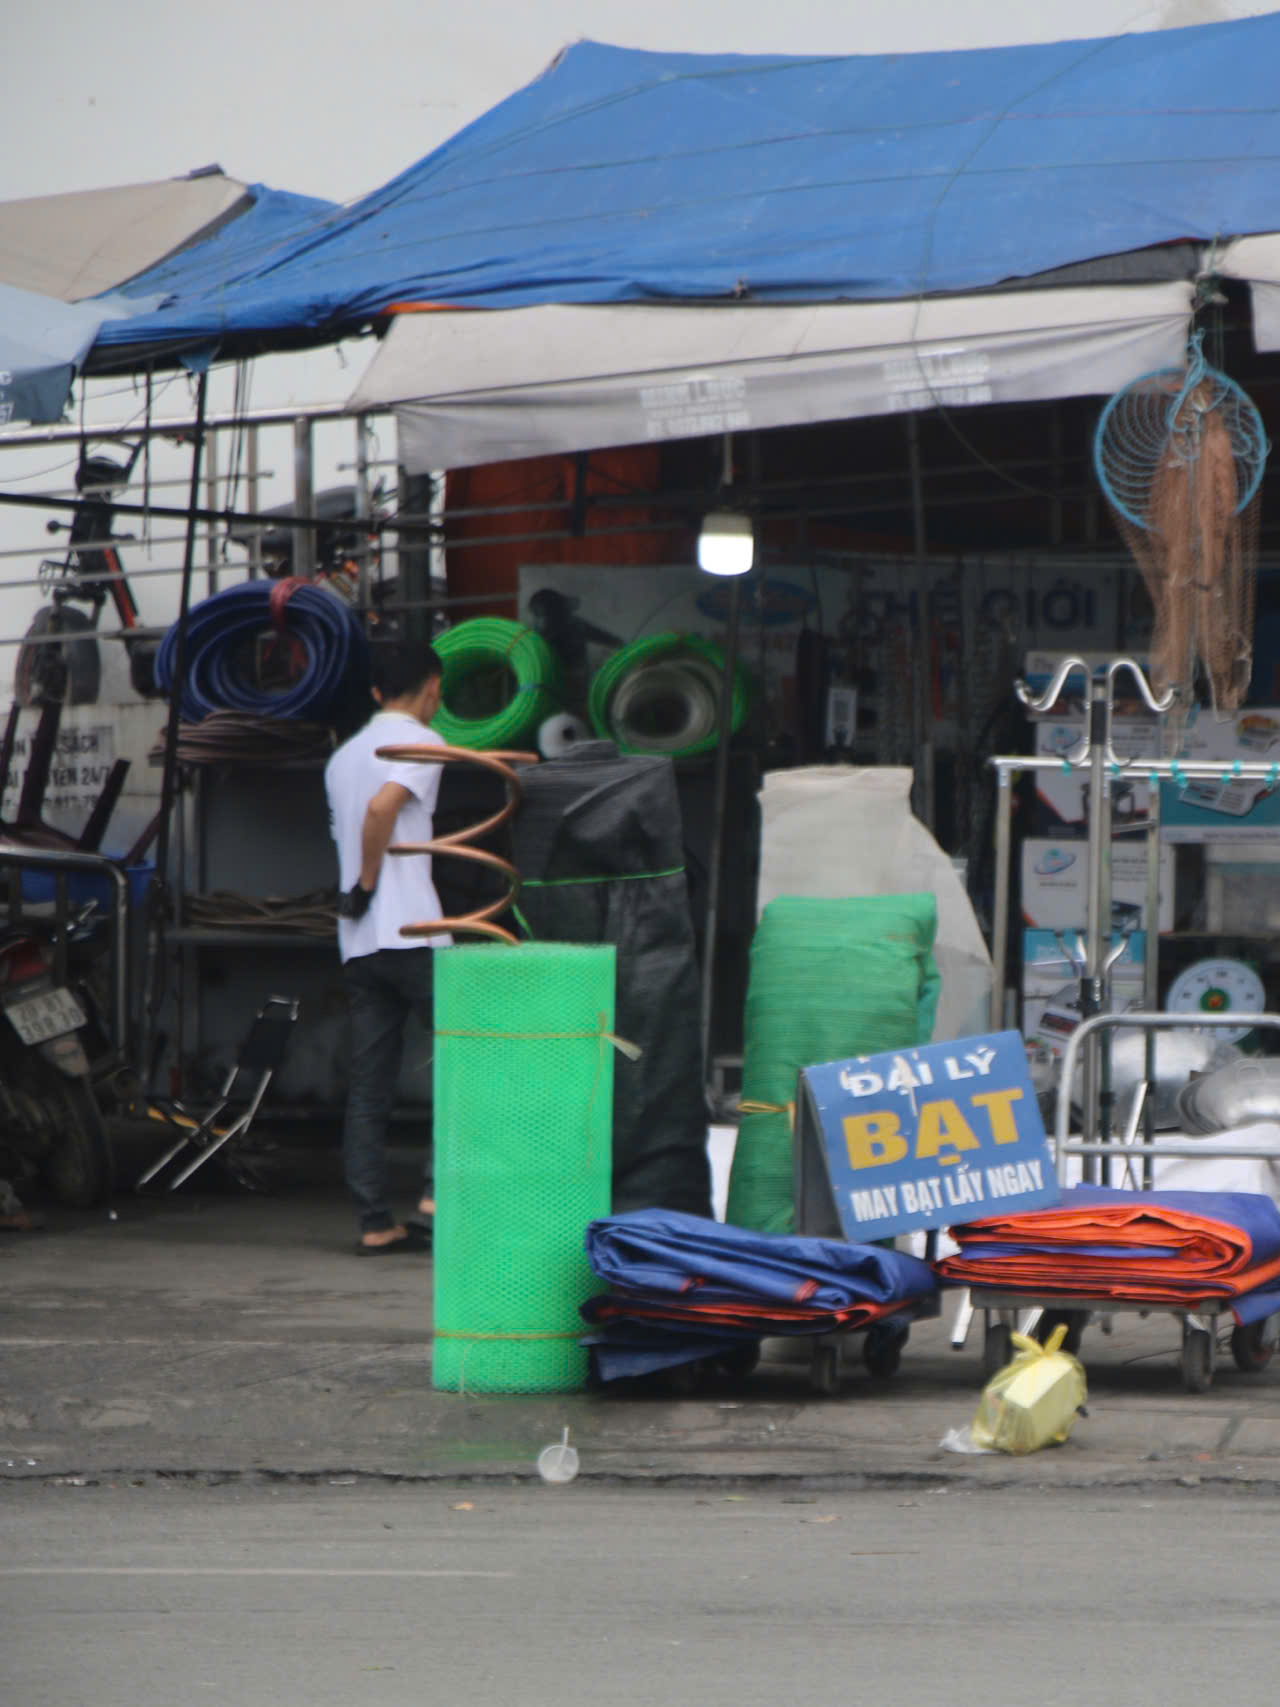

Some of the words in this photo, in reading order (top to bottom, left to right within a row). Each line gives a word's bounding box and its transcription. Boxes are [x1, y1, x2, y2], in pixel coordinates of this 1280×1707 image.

[844, 1052, 934, 1098] ĐẠI
[944, 1047, 997, 1080] LÝ
[841, 1087, 1025, 1170] BẠT
[850, 1186, 898, 1223] MAY
[901, 1177, 943, 1218] BẠT
[945, 1163, 985, 1206] LẤY
[986, 1160, 1045, 1199] NGAY
